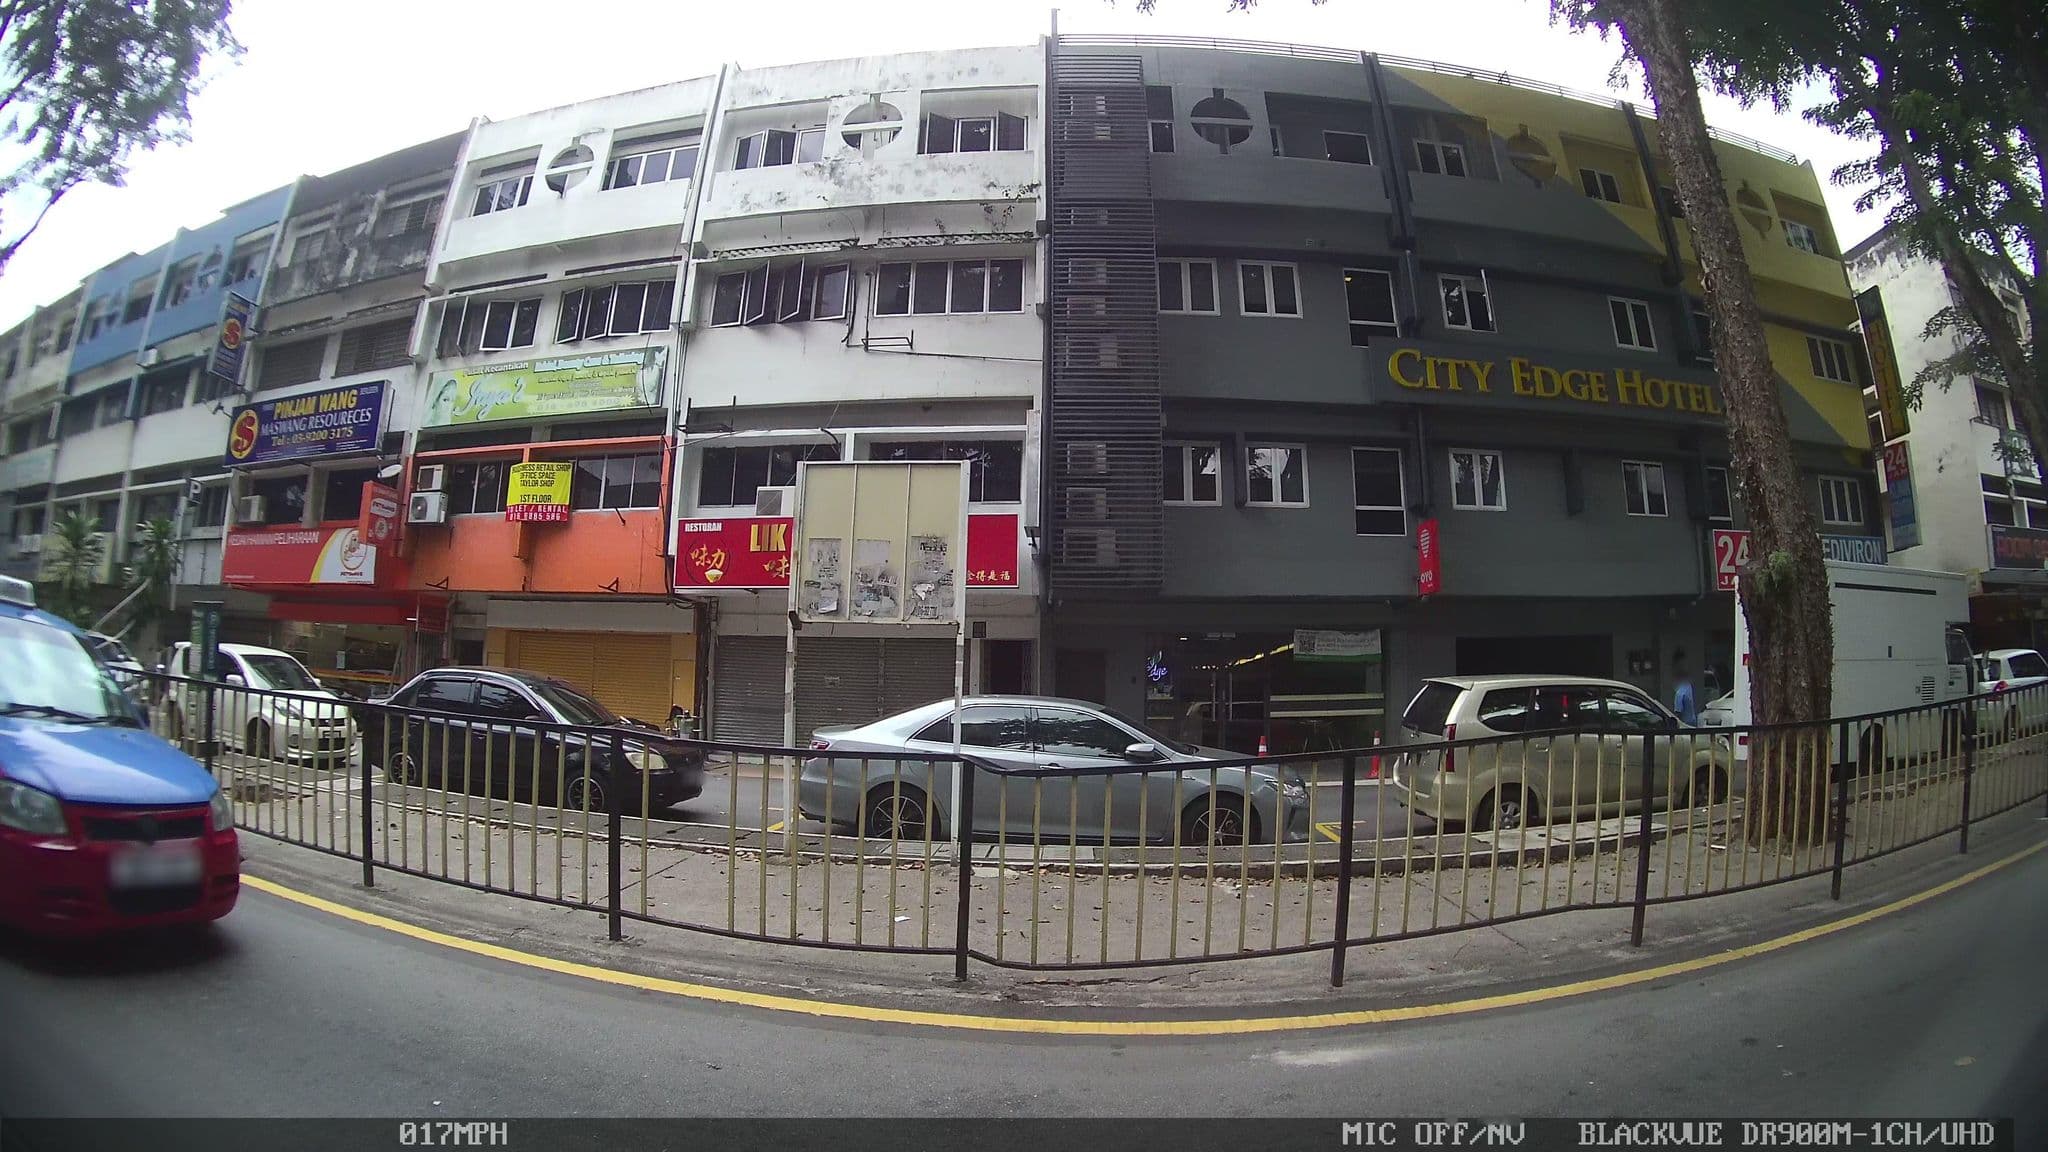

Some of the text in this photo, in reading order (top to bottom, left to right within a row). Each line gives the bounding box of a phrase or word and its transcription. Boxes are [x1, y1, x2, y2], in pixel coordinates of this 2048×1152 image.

[1389, 349, 1721, 415] CITY EDGE HOTEL
[273, 389, 357, 420] PINJAM WANG
[261, 408, 372, 436] MASWANG RESOURECES
[329, 427, 354, 440] 3175
[536, 463, 554, 472] RETAIL
[556, 464, 571, 472] SHOP
[191, 482, 201, 498] P
[540, 479, 555, 487] SHOP
[520, 494, 552, 503] 1ST FLOOR
[537, 505, 565, 513] RENTAL
[685, 522, 788, 552] RESTORAN LIK
[690, 544, 726, 569] 味力
[1822, 538, 1883, 564] EDIVIRON
